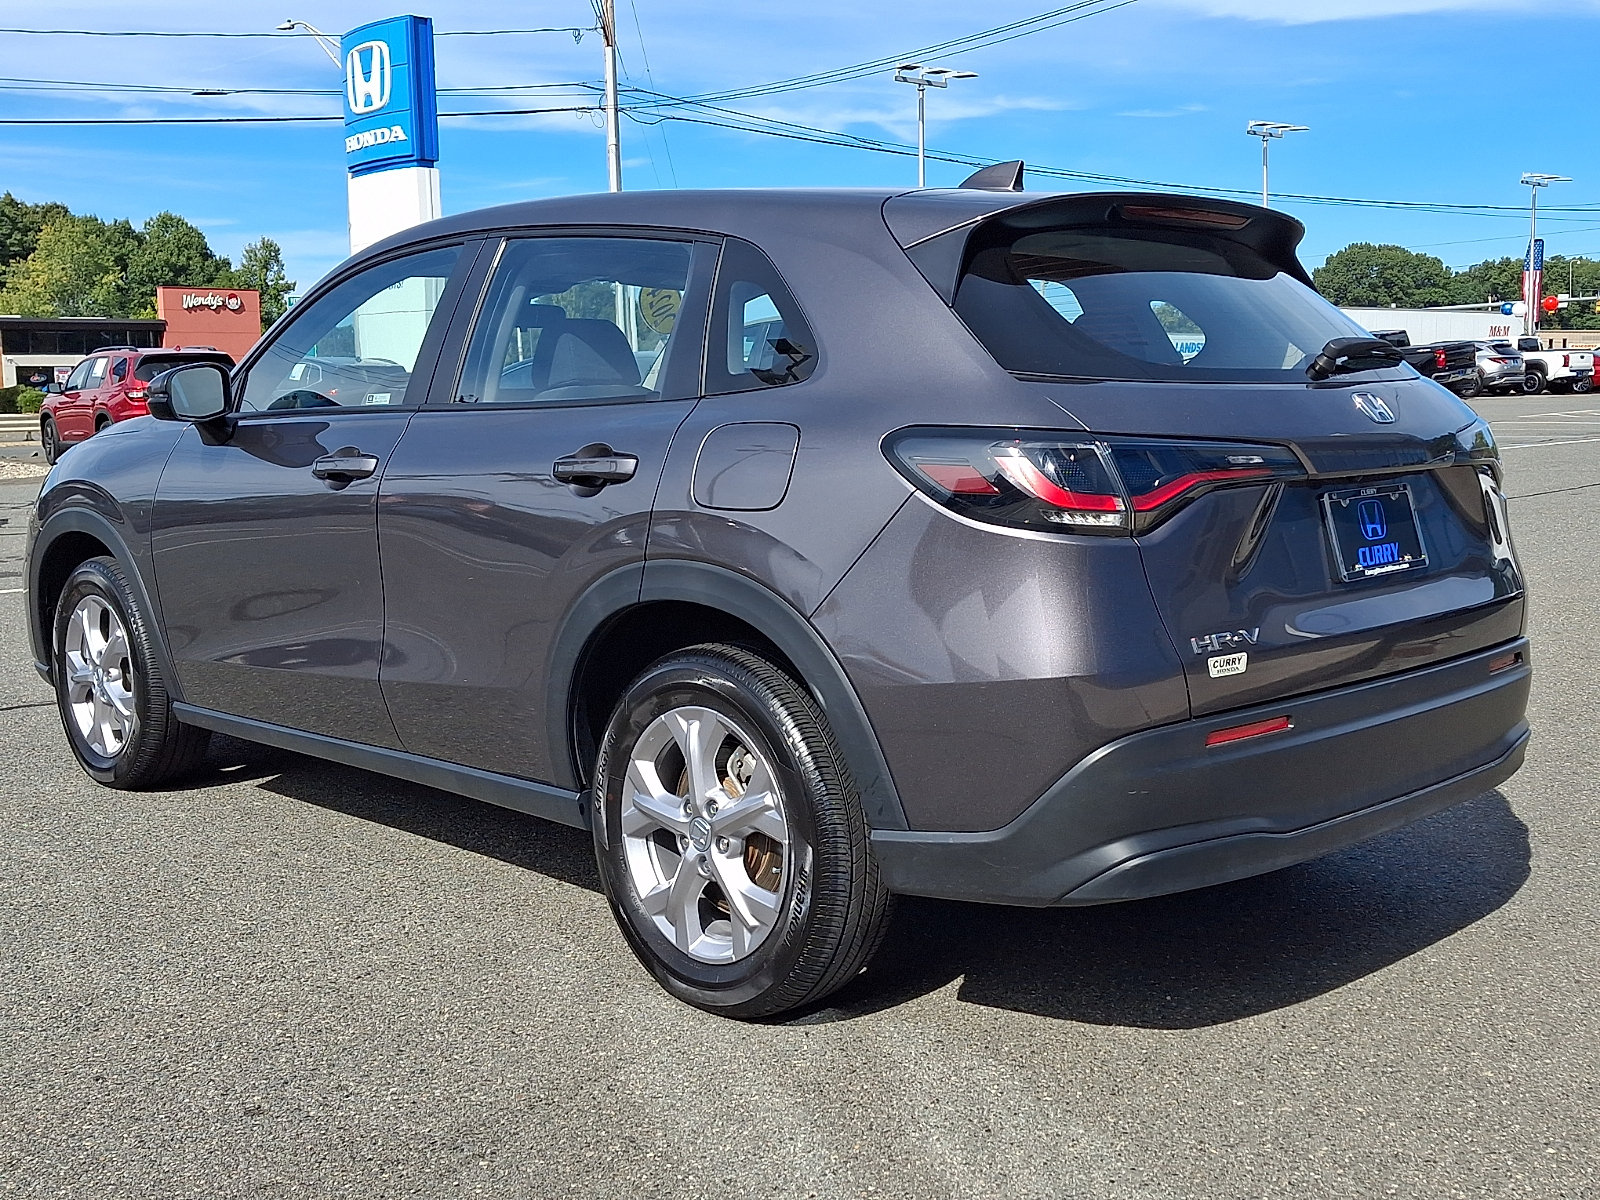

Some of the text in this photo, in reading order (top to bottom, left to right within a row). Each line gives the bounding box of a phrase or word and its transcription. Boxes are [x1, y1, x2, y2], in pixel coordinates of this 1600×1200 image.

[344, 125, 408, 154] HONDA
[182, 292, 223, 310] Wendy's
[1488, 325, 1511, 337] M&M
[1358, 542, 1399, 567] CURRY
[1190, 627, 1260, 654] HR-V
[1213, 656, 1243, 669] CURRY
[1216, 666, 1240, 674] HONDA
